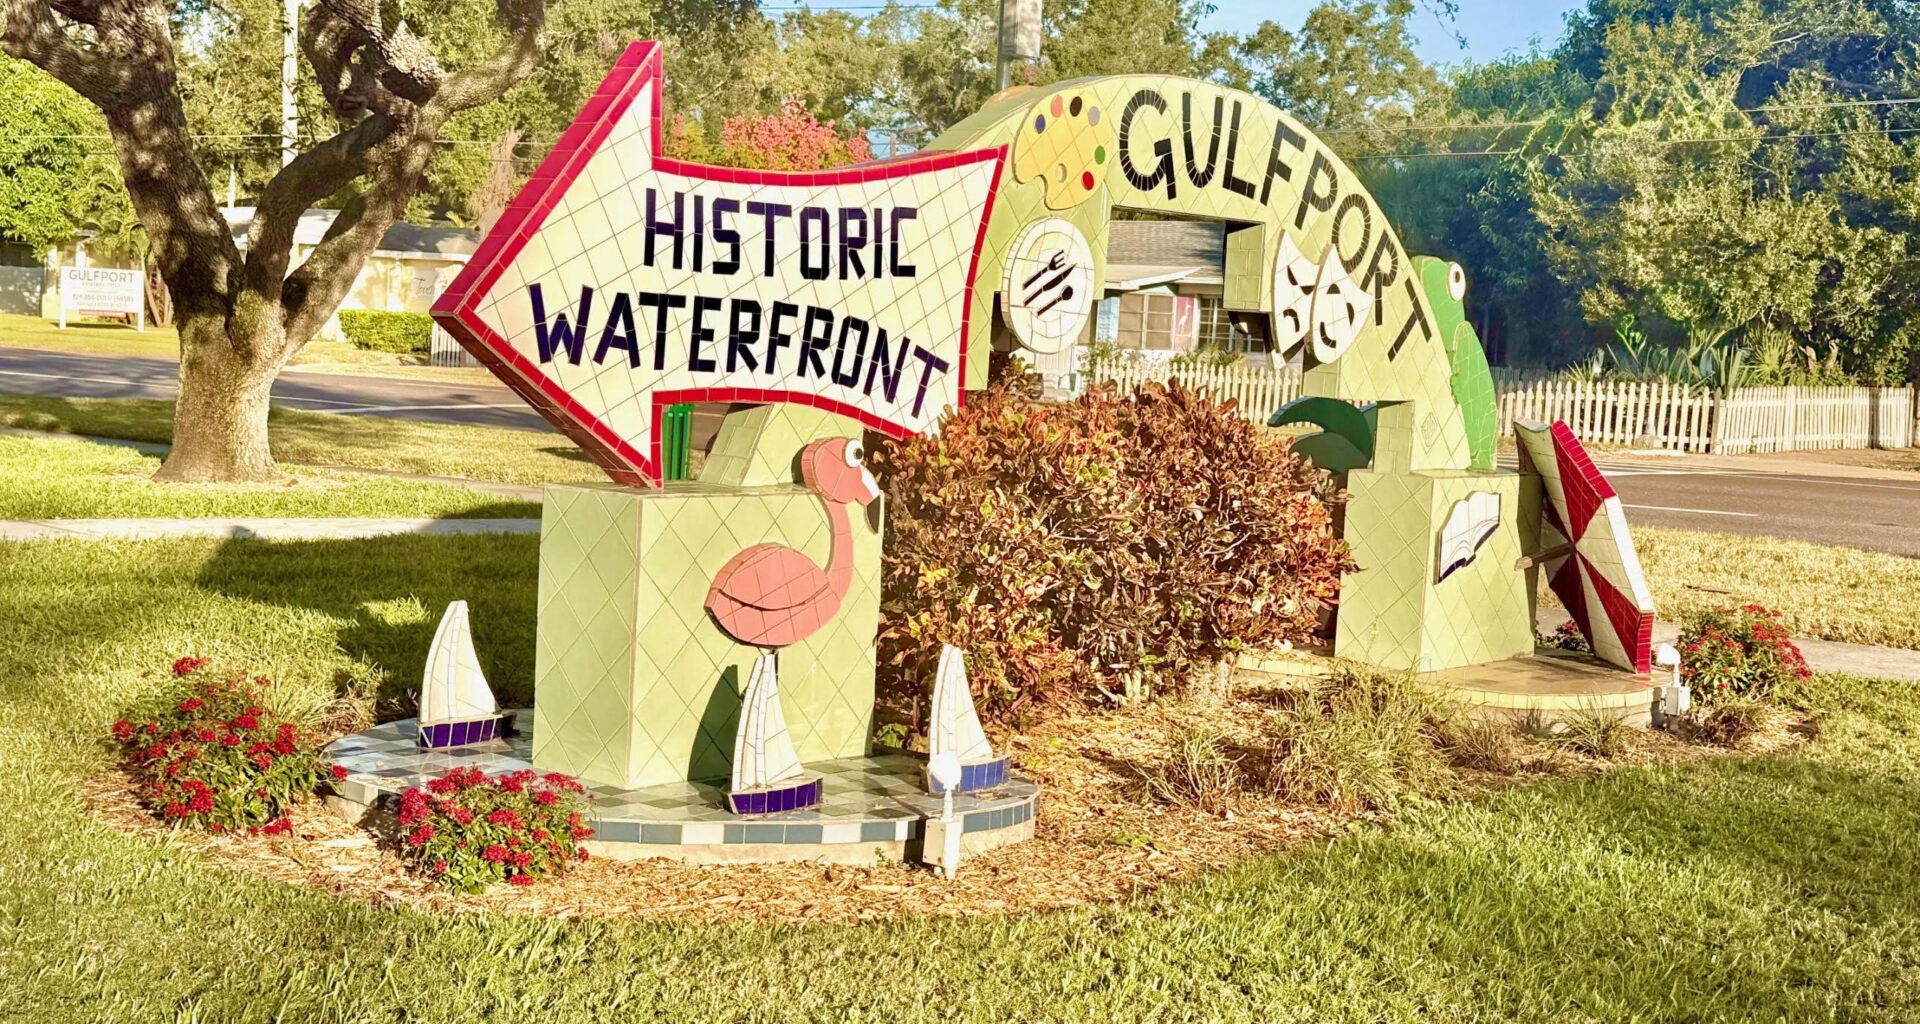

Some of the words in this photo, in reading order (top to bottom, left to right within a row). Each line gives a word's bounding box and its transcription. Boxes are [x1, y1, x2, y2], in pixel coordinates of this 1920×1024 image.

[68, 269, 135, 283] GULFPORT
[643, 188, 918, 281] HISTORIC
[1119, 89, 1432, 362] GULFPORT
[529, 283, 949, 418] WATERFRONT
